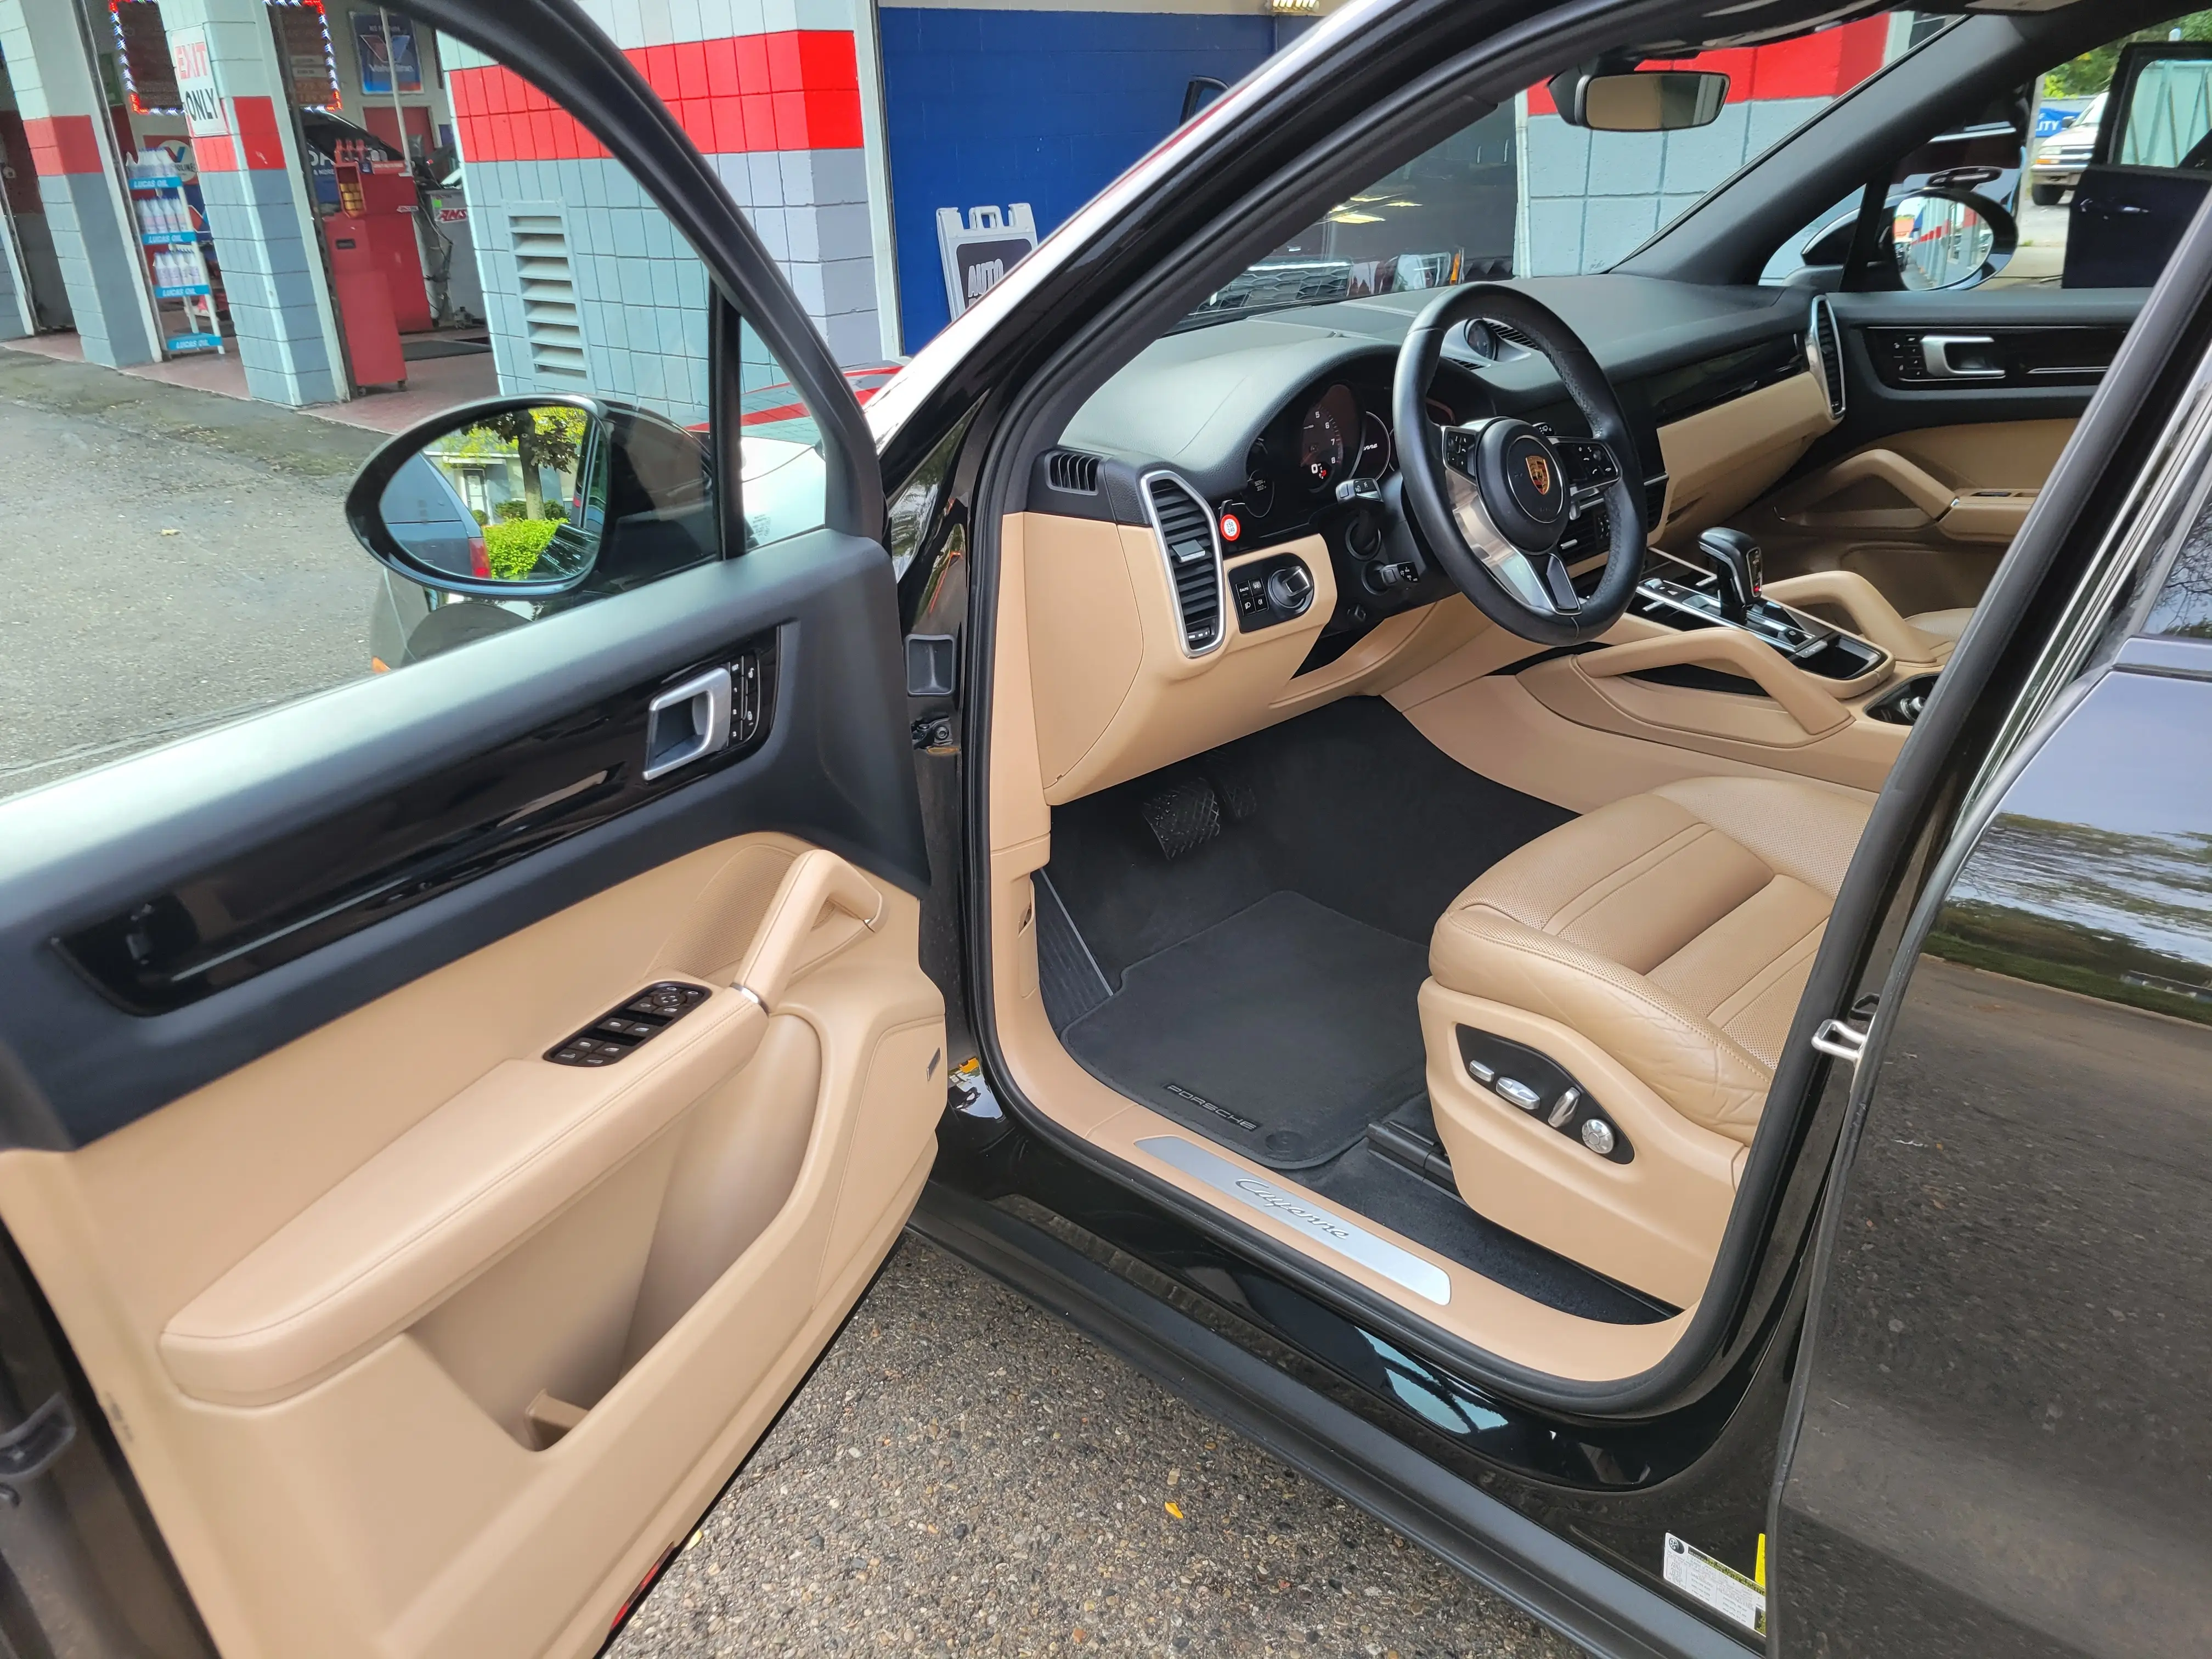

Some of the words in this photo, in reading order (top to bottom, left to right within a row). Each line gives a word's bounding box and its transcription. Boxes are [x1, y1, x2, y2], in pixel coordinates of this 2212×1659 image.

[174, 42, 207, 80] EXIT
[185, 88, 218, 121] ONLY
[134, 179, 156, 188] LUCAS
[157, 179, 169, 187] OIL
[149, 235, 170, 243] LUCAS
[162, 289, 183, 297] LUCAS
[968, 258, 1003, 297] AUTO
[176, 341, 197, 349] LUCAS
[1167, 1085, 1257, 1130] PORSCHE
[1235, 1178, 1349, 1239] Cayenne
